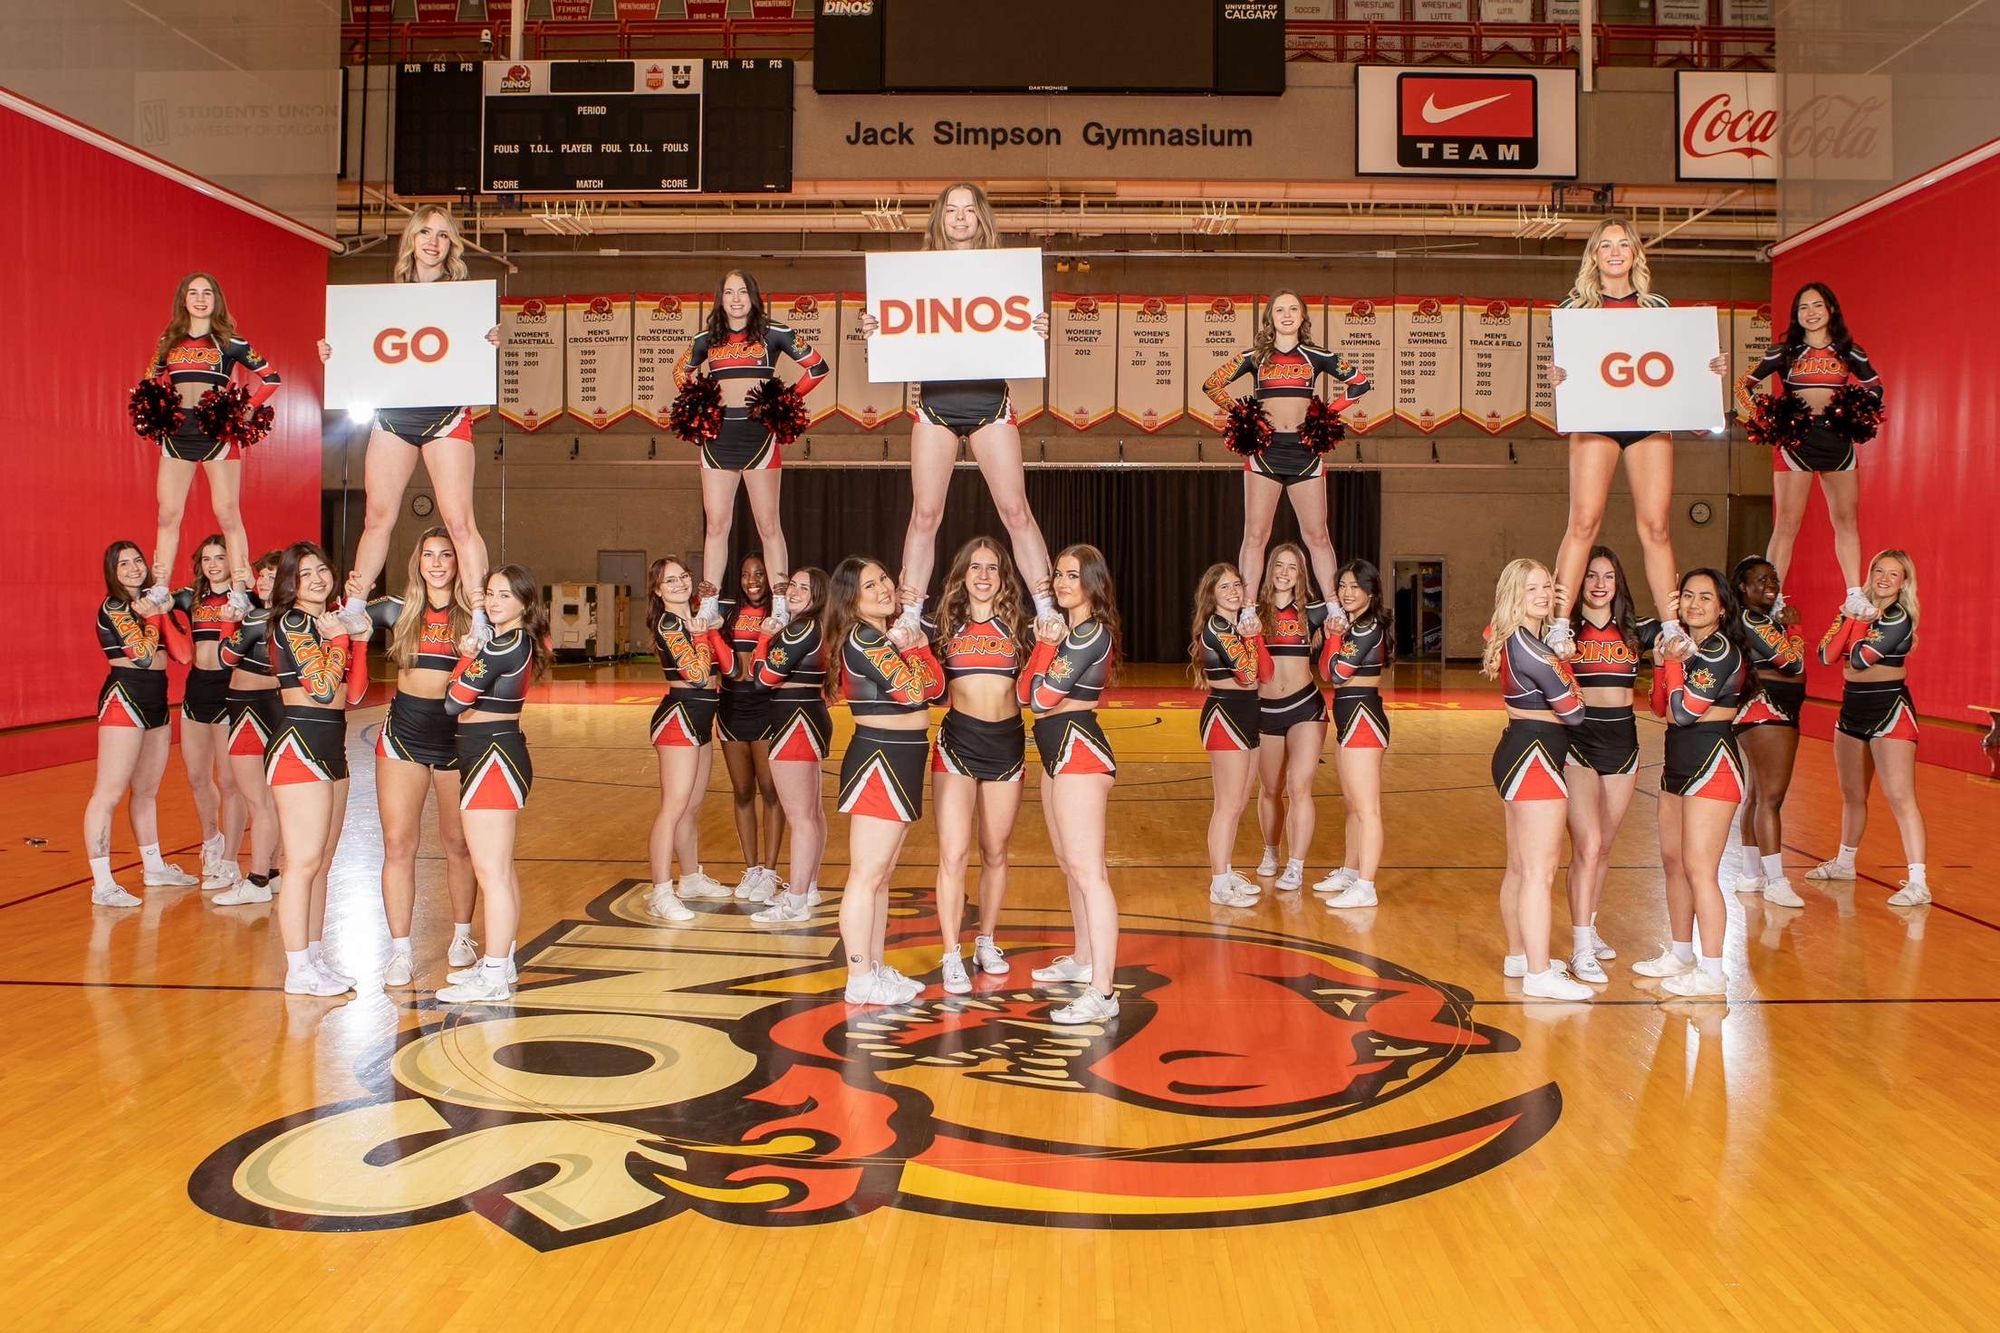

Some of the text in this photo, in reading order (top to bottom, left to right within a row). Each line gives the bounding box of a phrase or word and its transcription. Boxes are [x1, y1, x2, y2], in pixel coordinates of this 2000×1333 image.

[823, 1, 874, 16] DINOS
[1294, 6, 1321, 14] SOCCER
[1421, 1, 1462, 9] WRESTLING
[1225, 10, 1278, 20] CALGARY
[1430, 12, 1453, 20] LUTTE
[404, 63, 473, 73] PLYR FLS PTS
[711, 59, 783, 69] PLYR FLS PTS
[501, 79, 531, 89] DINOS
[577, 106, 607, 115] PERIOD
[846, 121, 1253, 151] Jack Simpson Gymnasium
[493, 143, 689, 154] FOULS T.O.L. PLAYER FOUL T.O.L. FOULS
[1416, 142, 1521, 161] TEAM
[492, 179, 688, 189] SCORE MATCH SCORE
[516, 314, 547, 325] DINOS
[583, 312, 614, 322] DINOS
[651, 312, 682, 321] DINOS
[787, 311, 819, 321] DINOS
[880, 295, 1032, 335] DINOS
[1068, 312, 1100, 321] DINOS
[1136, 313, 1168, 323] DINOS
[1204, 313, 1236, 323] DINOS
[1411, 314, 1443, 324] DINOS
[1345, 316, 1377, 325] DINOS
[1480, 316, 1512, 326] DINOS
[1065, 328, 1102, 336] WOMEN'S
[594, 335, 629, 343] COUNTRY
[1469, 339, 1494, 347] TRACK
[373, 326, 449, 365] GO
[1601, 351, 1674, 388] GO
[946, 634, 1016, 658] DINOS
